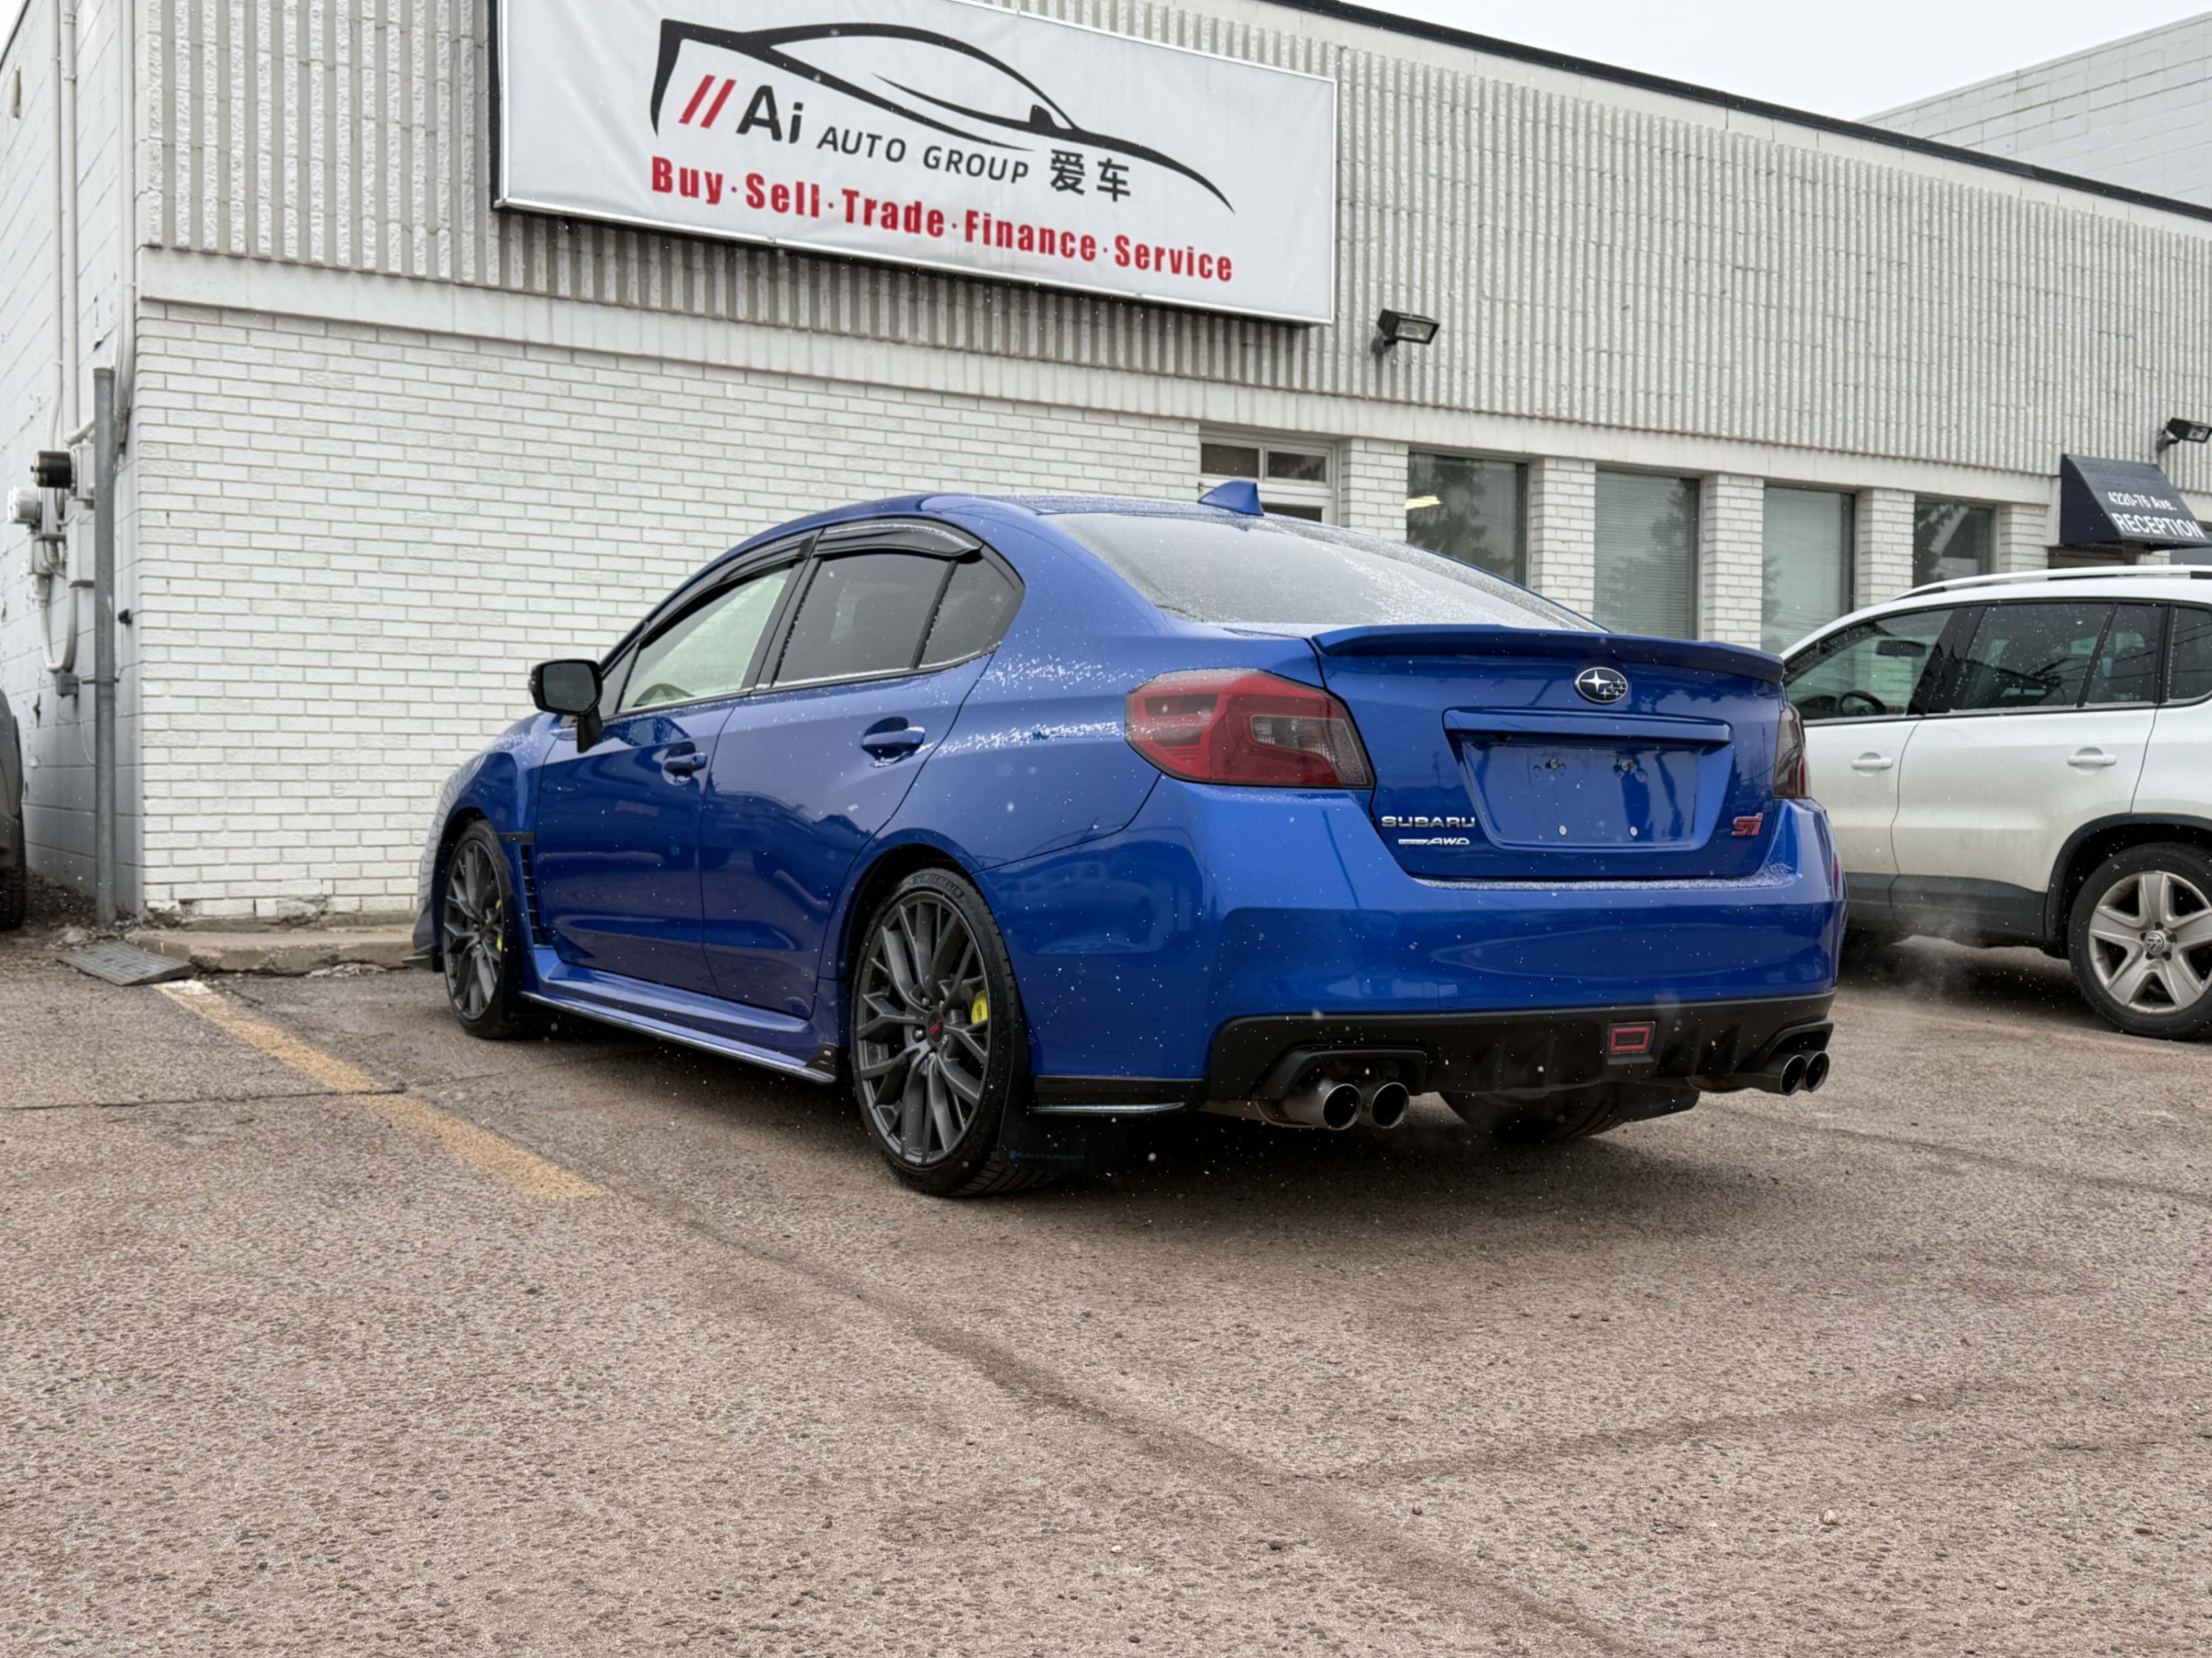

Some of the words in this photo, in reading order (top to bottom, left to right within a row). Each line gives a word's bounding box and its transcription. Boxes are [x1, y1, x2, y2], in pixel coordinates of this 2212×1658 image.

[817, 127, 906, 162] AUTO
[923, 146, 1029, 184] GROUP
[1050, 149, 1131, 202] 爱车
[652, 156, 723, 205] Buy
[746, 173, 820, 218] Sell
[842, 189, 945, 238] Trade
[965, 210, 1096, 262] Finance
[1114, 236, 1232, 282] Service
[2151, 495, 2178, 511] Ave.
[2111, 512, 2205, 539] RECEPTION
[1381, 816, 1475, 828] SUBARU
[1426, 837, 1470, 846] AWD
